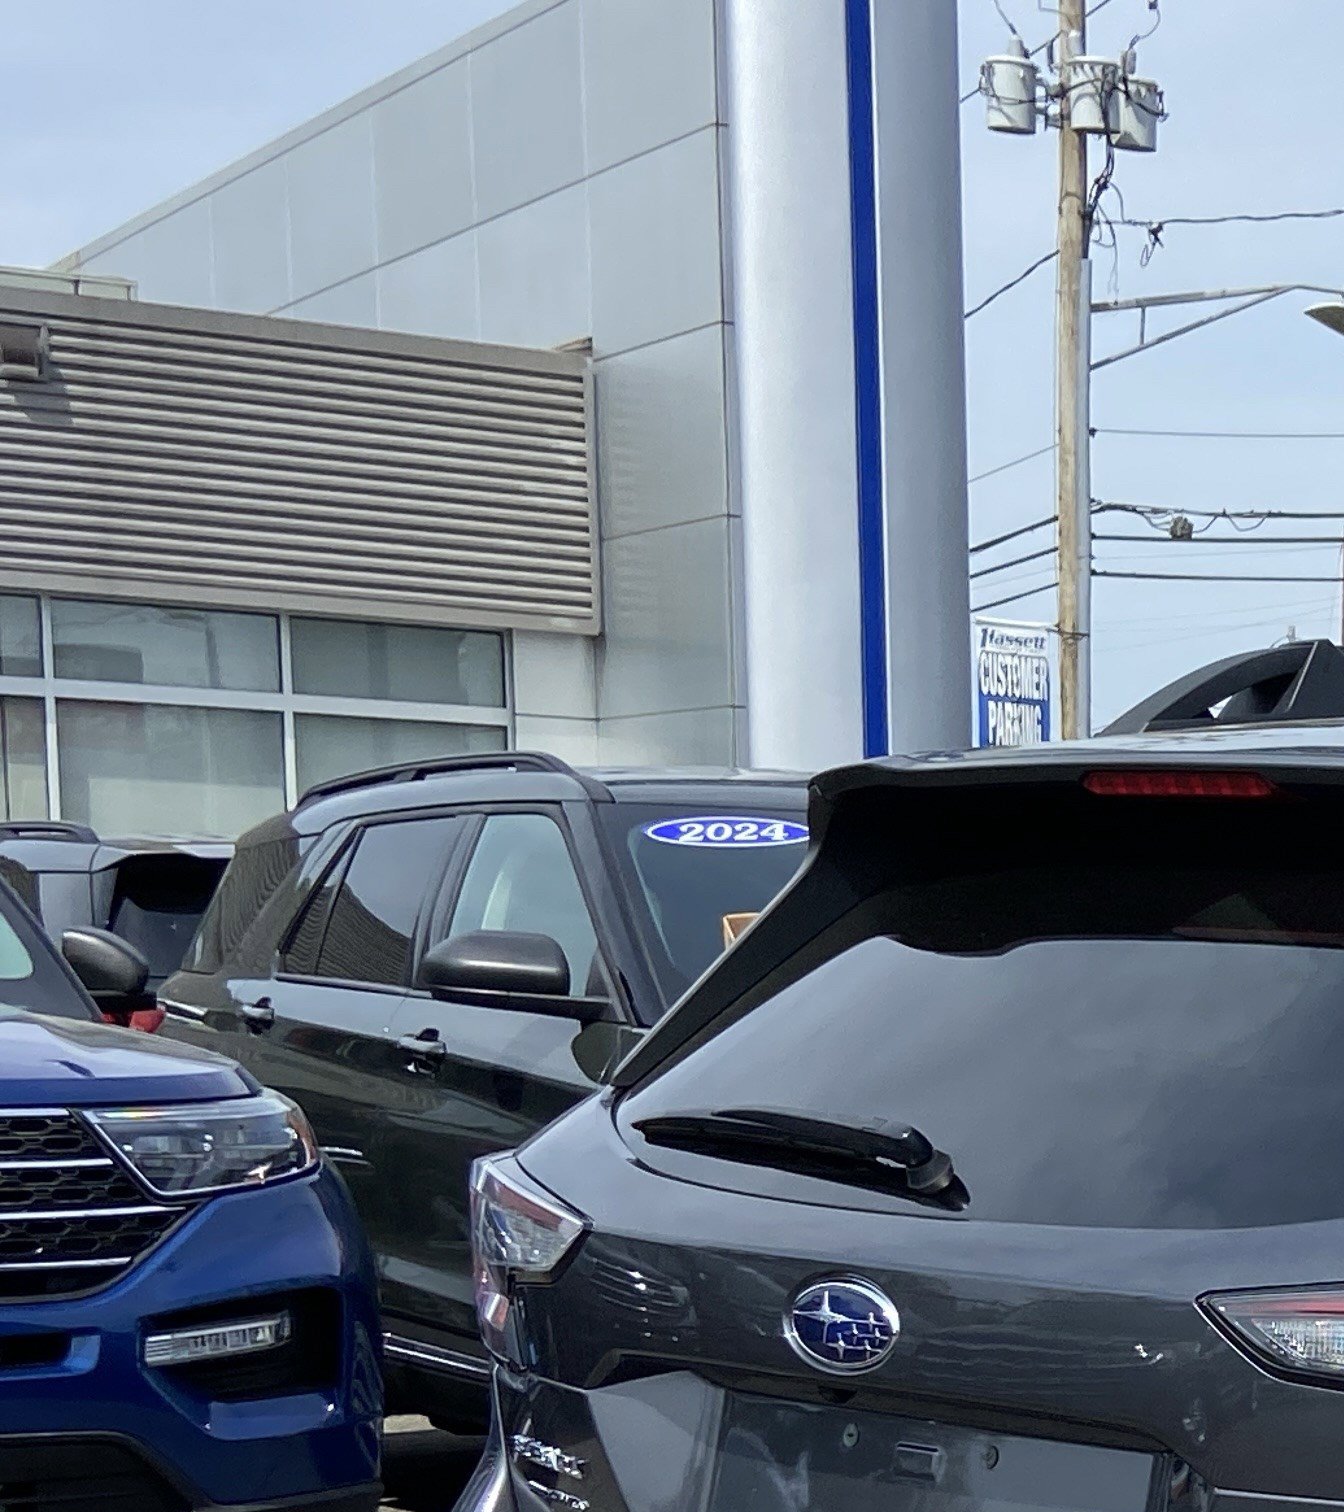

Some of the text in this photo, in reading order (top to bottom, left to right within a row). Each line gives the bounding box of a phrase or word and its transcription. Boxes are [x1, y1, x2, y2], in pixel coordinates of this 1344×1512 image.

[979, 652, 1050, 701] CUSTOMER
[988, 700, 1043, 747] PARKING
[678, 822, 789, 843] 2024
